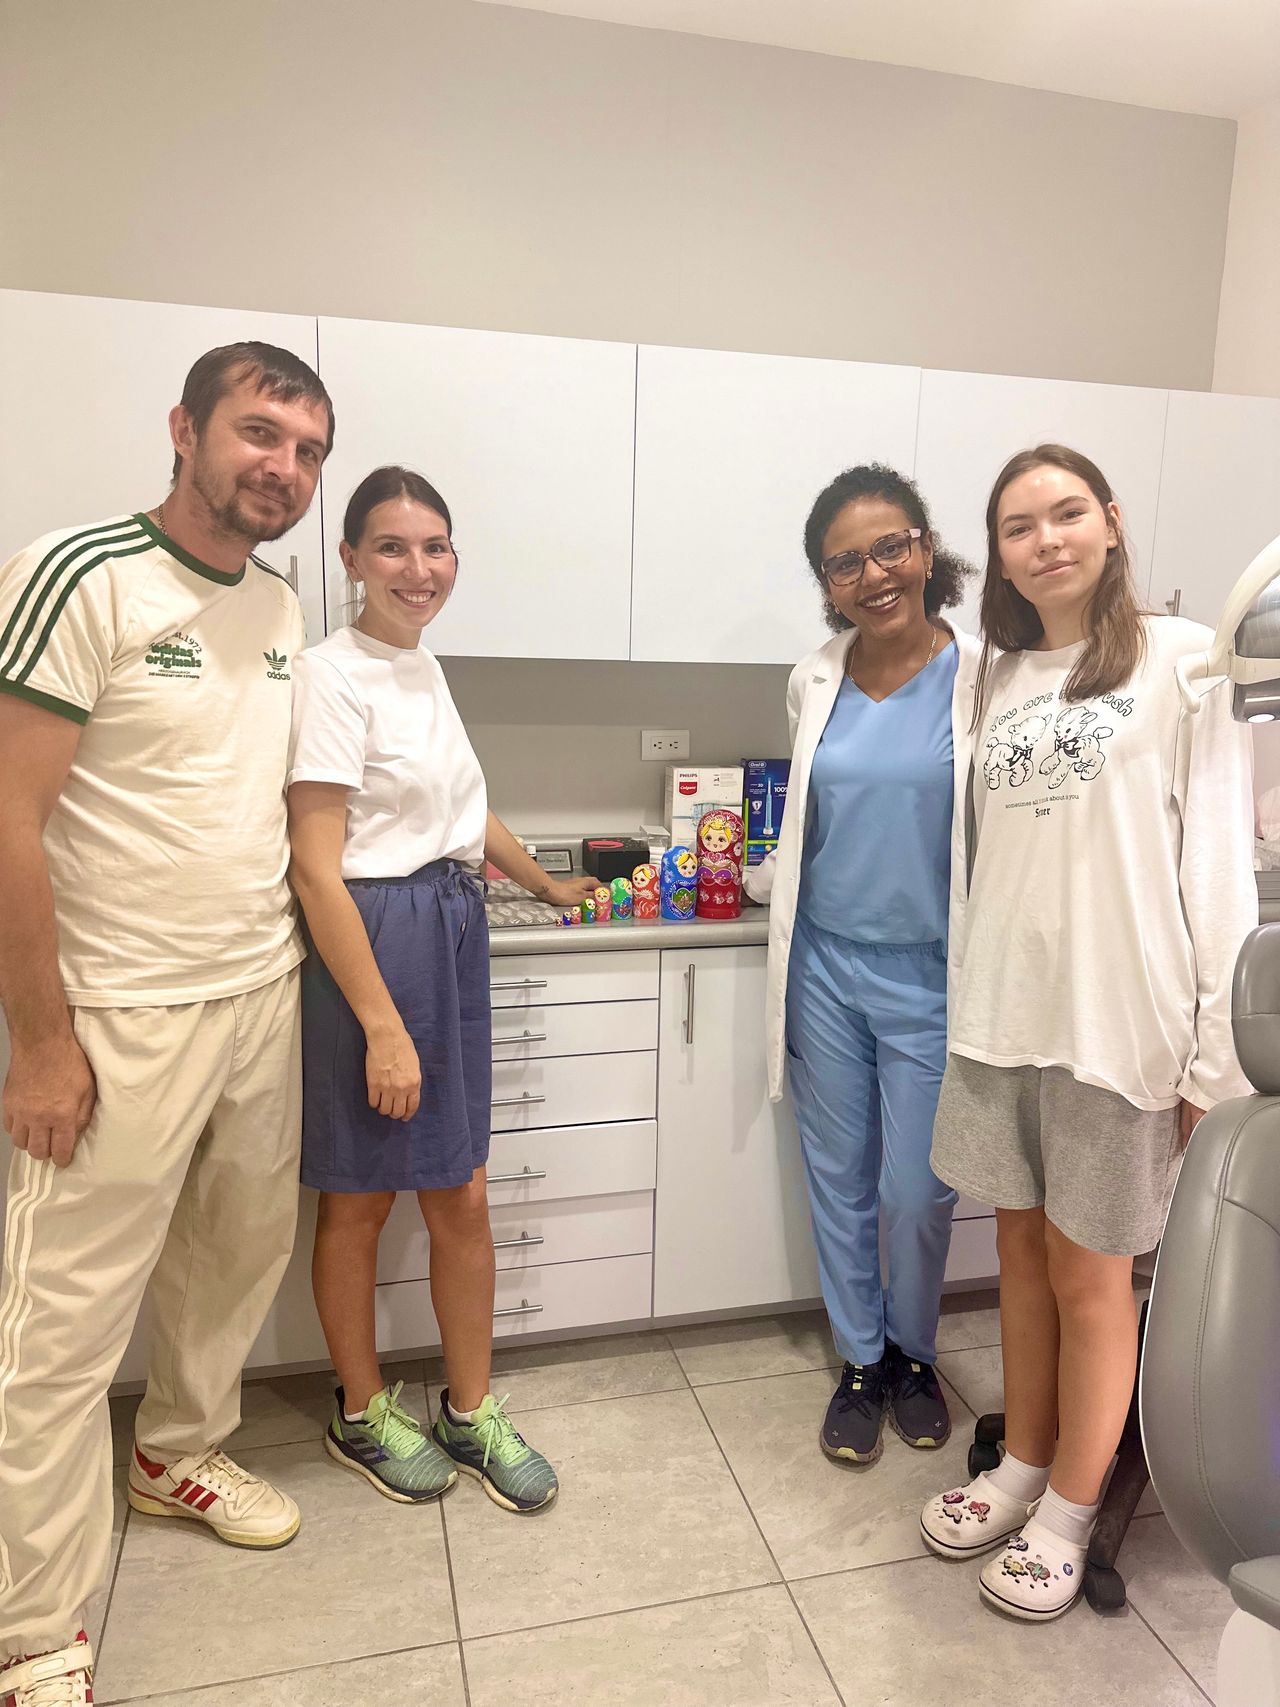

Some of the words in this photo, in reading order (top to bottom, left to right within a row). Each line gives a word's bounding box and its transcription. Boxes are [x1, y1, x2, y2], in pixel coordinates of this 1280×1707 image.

[151, 643, 194, 657] adidas
[145, 654, 202, 669] originals
[266, 671, 291, 681] adidas
[1023, 692, 1054, 710] are
